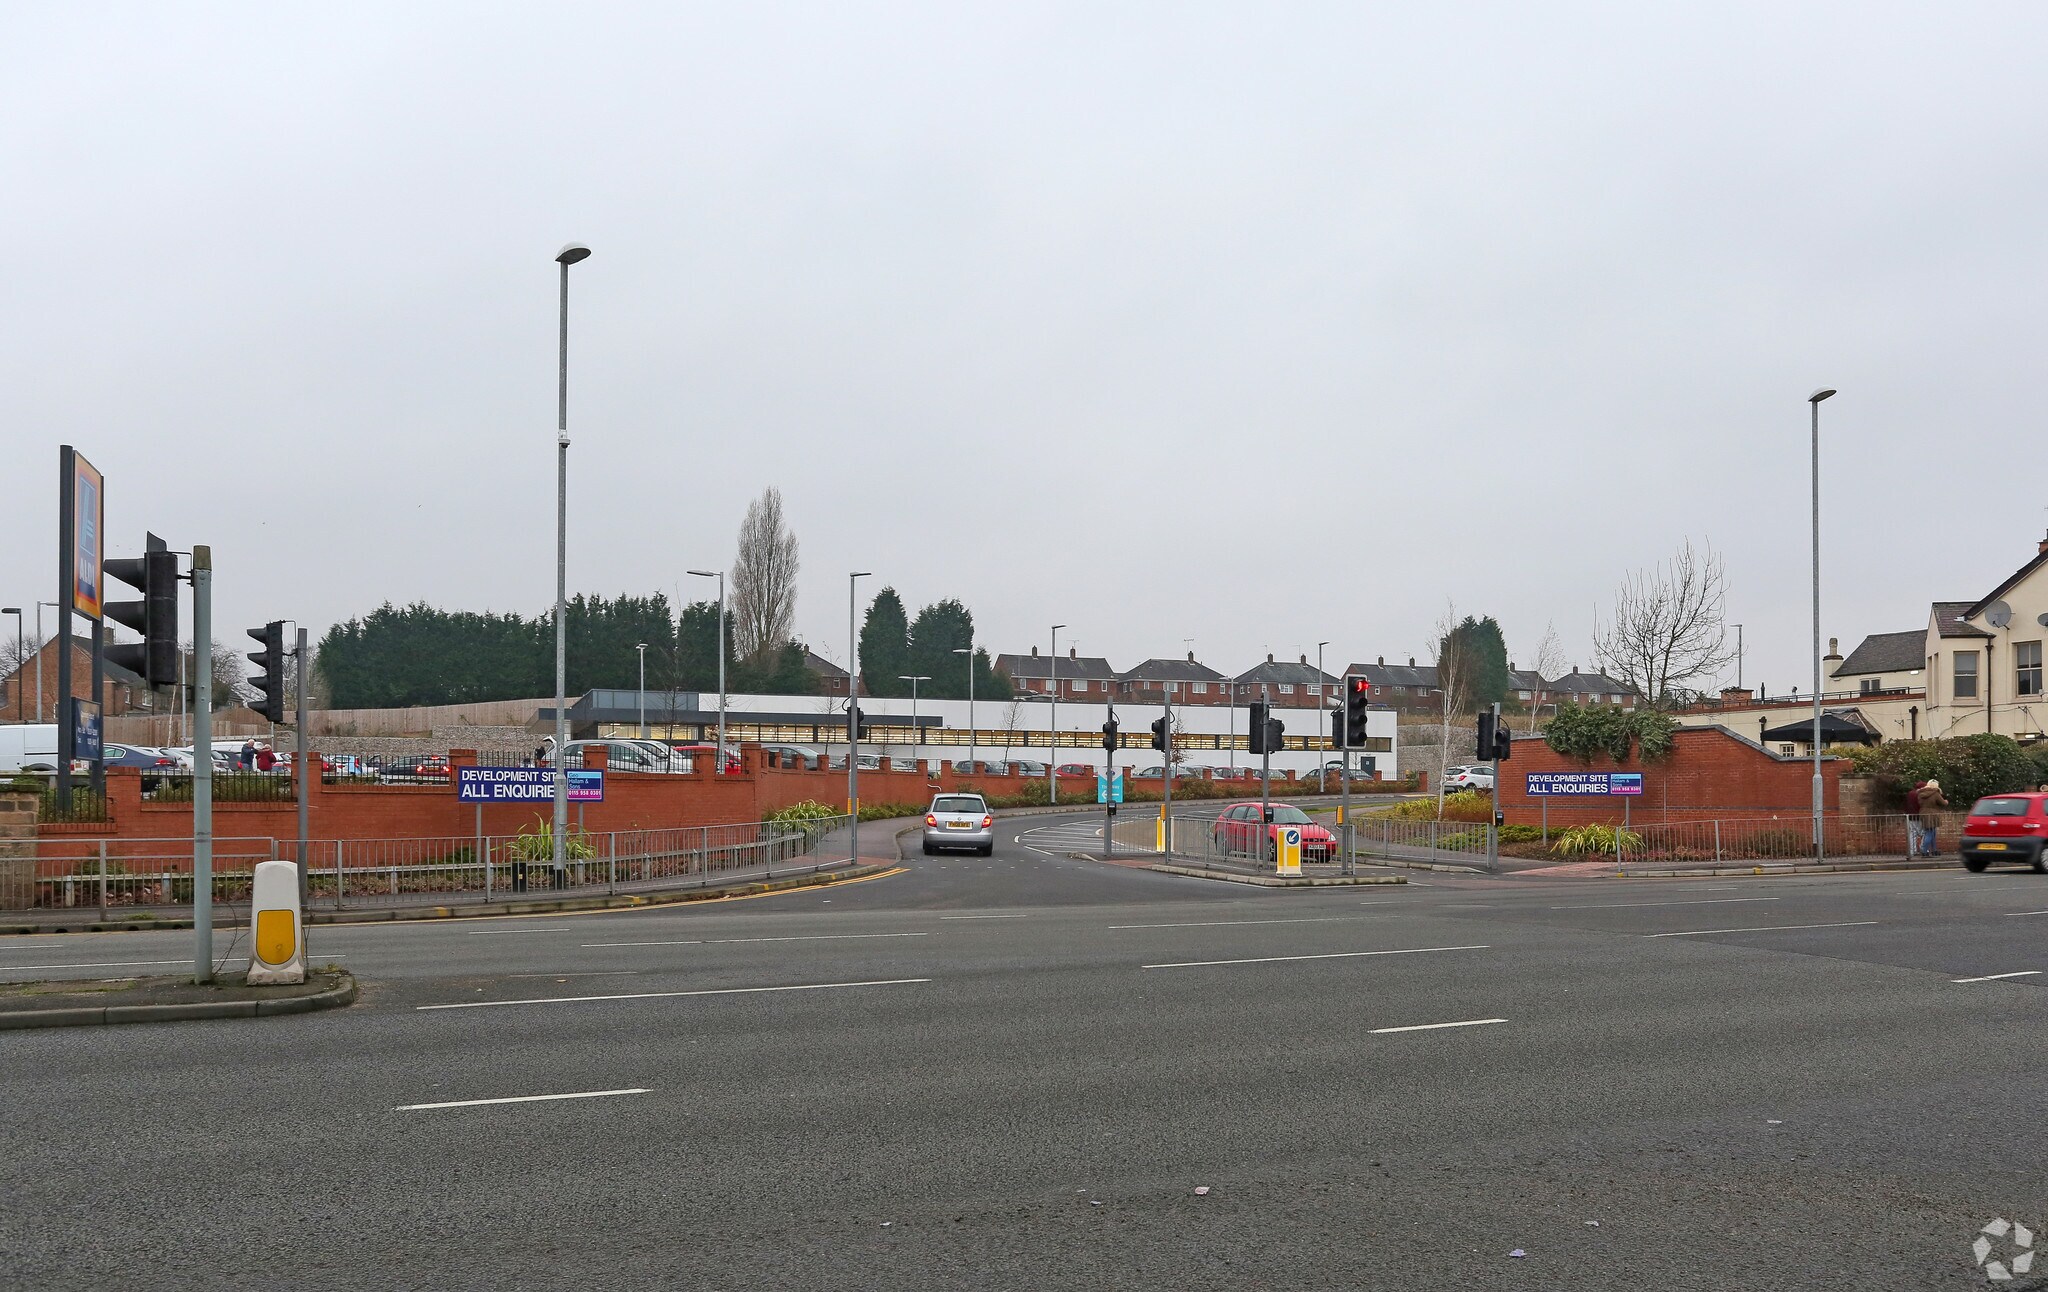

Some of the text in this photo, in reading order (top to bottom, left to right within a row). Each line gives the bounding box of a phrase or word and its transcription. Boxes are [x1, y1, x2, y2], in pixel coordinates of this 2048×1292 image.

[79, 558, 95, 587] ALDI
[461, 770, 556, 782] DEVELOPMENT SIT
[1589, 774, 1608, 782] SITE
[461, 784, 555, 798] ALL ENQUIRIE
[1528, 783, 1608, 793] ALL ENQUIRIES
